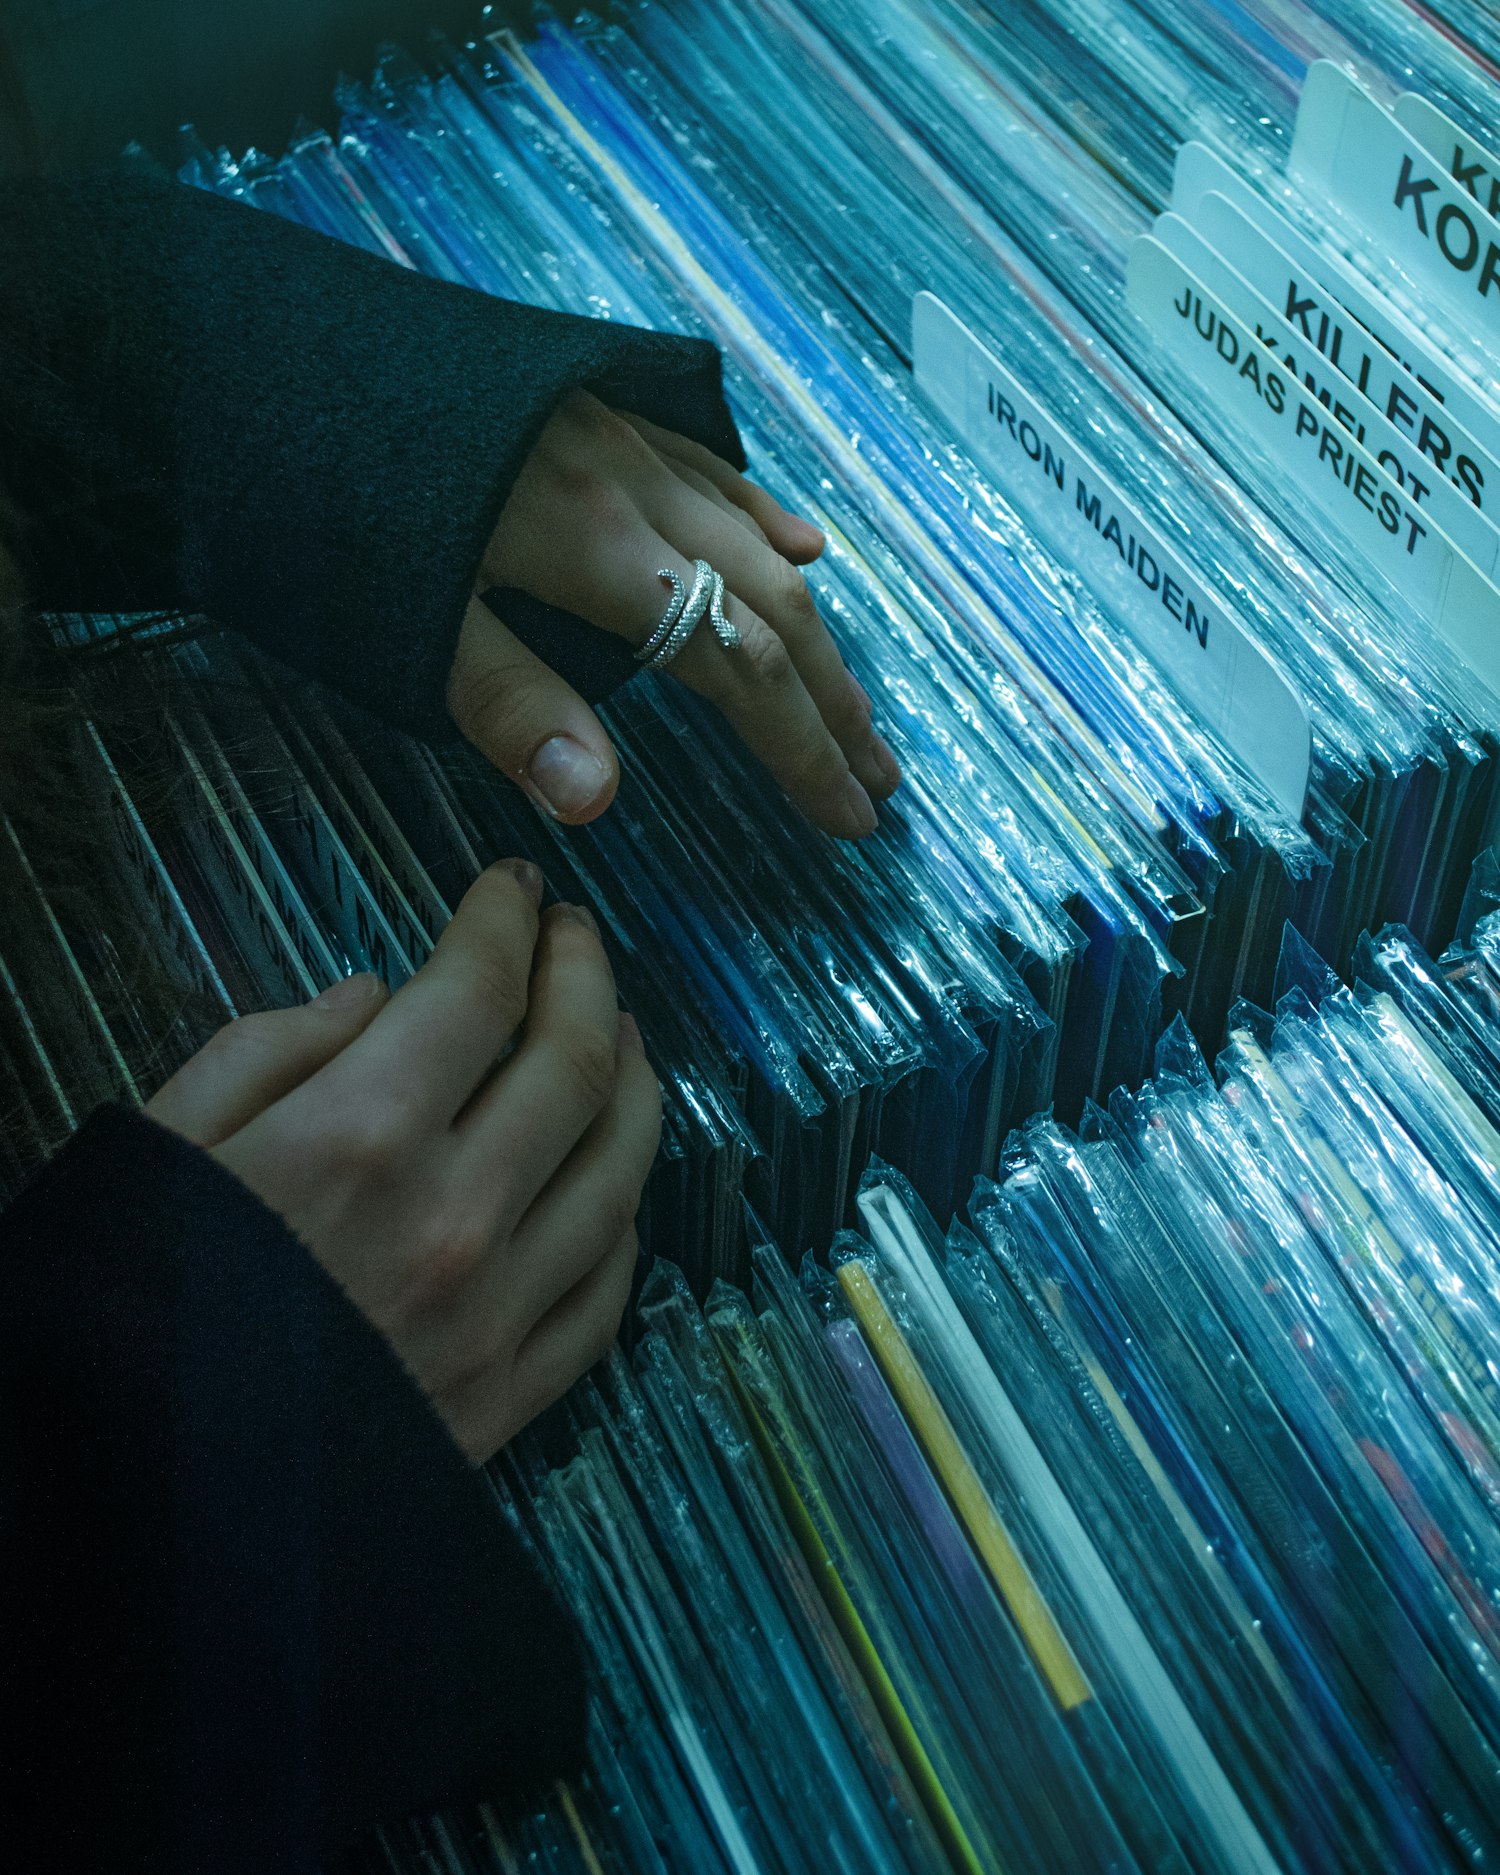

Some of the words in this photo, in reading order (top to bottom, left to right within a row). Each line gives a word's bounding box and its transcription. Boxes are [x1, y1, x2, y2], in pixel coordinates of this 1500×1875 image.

[987, 381, 1066, 491] IRON
[1075, 477, 1210, 651] MAIDEN
[1174, 287, 1286, 415] JUDAS
[1296, 402, 1428, 556] PRIEST
[1286, 279, 1484, 510] KILLERS
